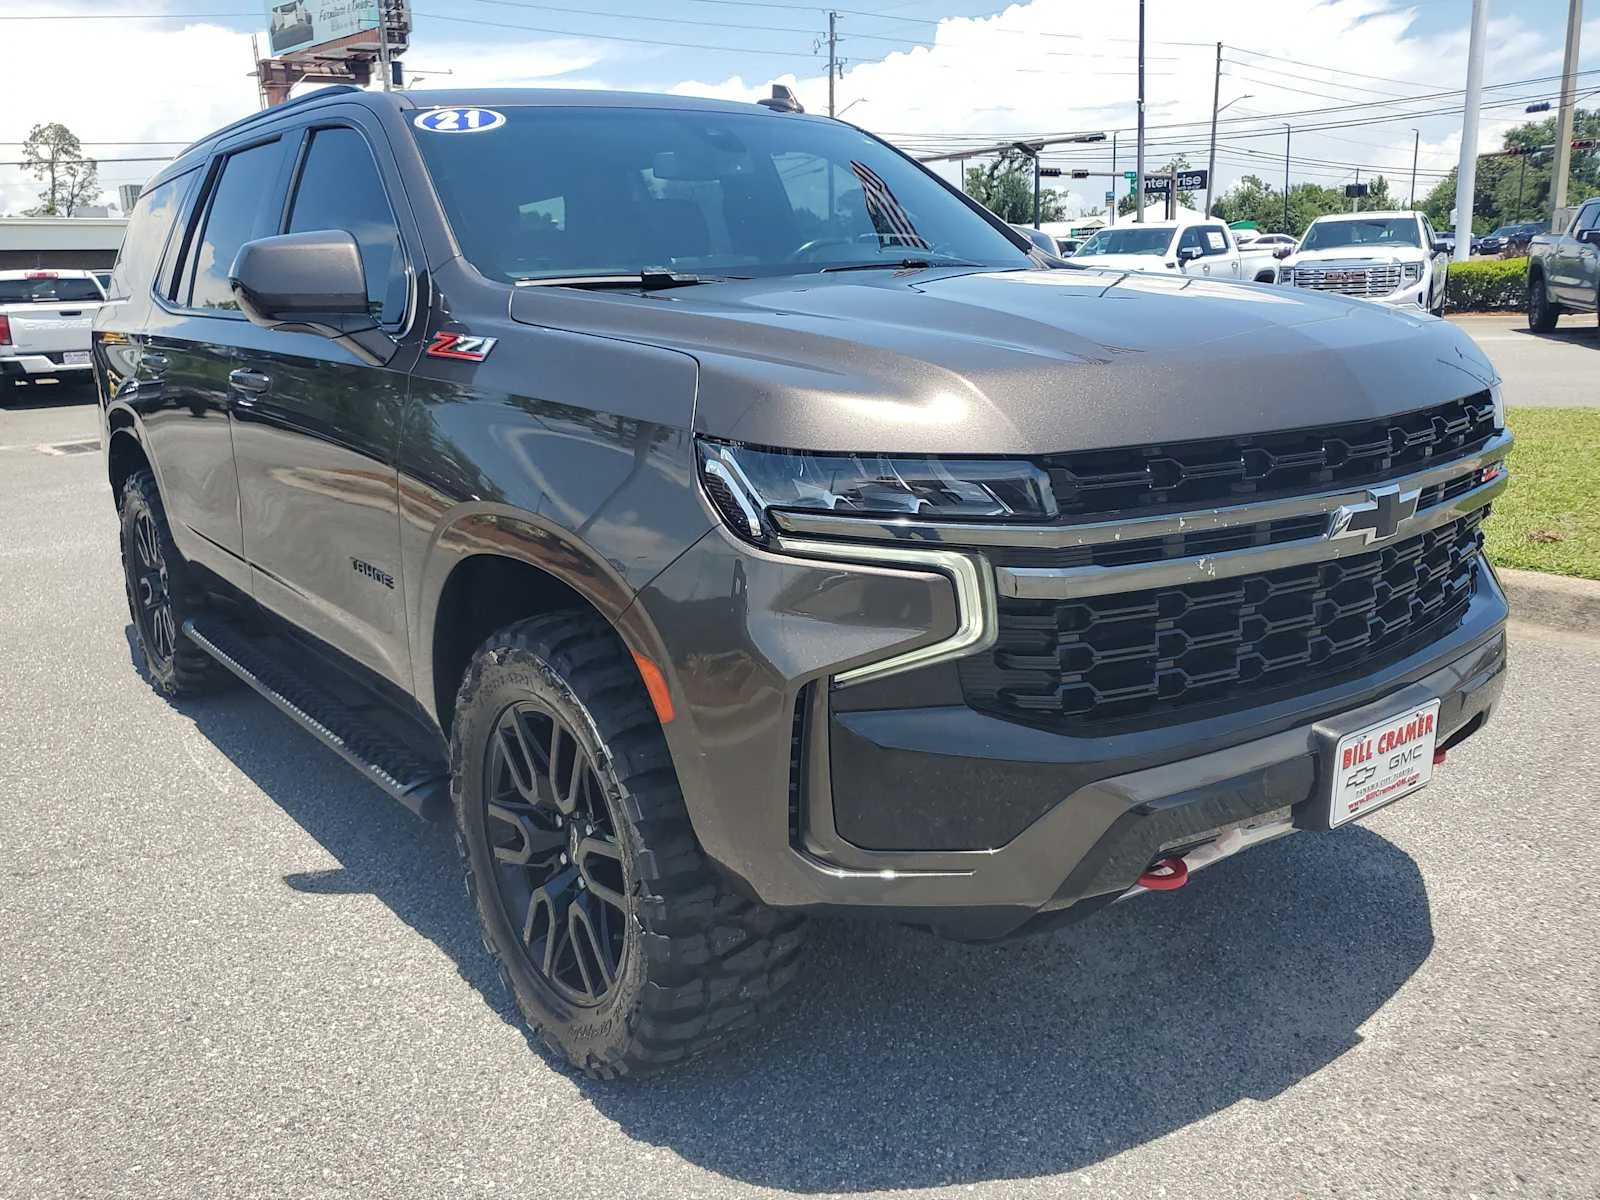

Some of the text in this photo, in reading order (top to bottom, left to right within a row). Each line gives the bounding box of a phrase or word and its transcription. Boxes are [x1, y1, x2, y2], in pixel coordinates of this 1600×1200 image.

[435, 111, 481, 130] 21
[1144, 175, 1202, 189] nterrise
[427, 331, 498, 362] Z71
[1342, 714, 1434, 770] BILL CRAMER
[1389, 744, 1423, 769] GMC
